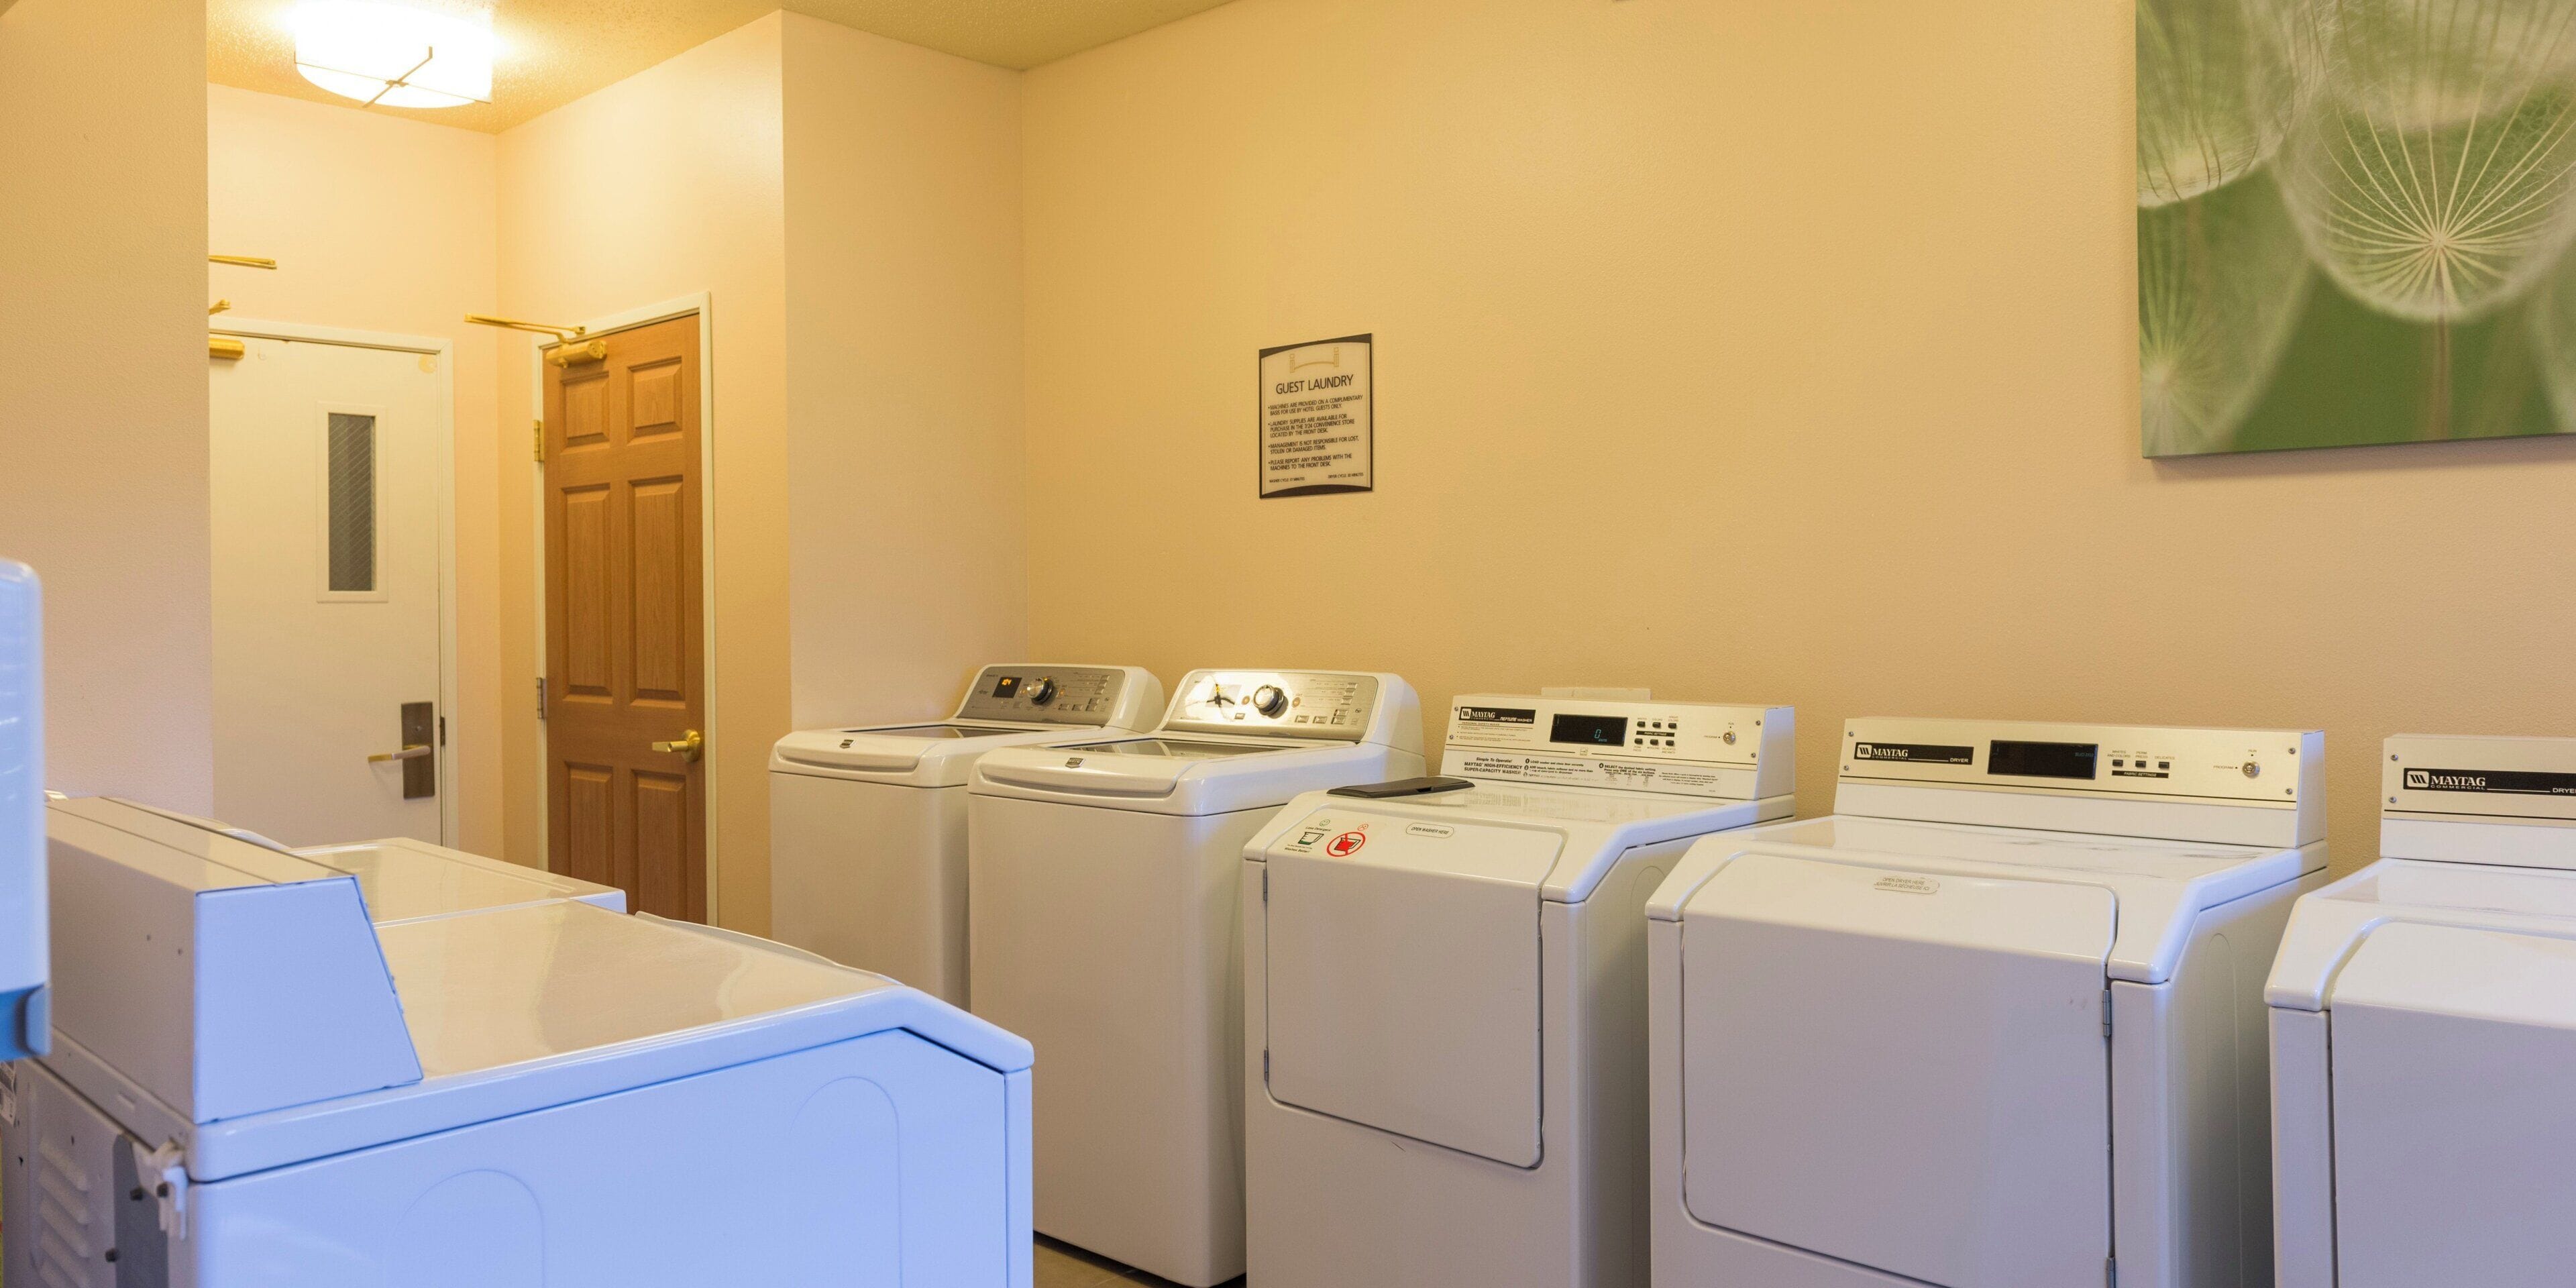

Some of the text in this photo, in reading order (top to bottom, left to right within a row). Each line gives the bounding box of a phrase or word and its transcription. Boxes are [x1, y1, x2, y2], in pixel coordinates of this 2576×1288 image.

[1276, 374, 1354, 394] GUEST LAUNDRY
[1330, 394, 1363, 402] COMPLIMENTARY
[1594, 729, 1602, 739] 0
[1873, 749, 1908, 757] MAYTAG
[2430, 775, 2485, 786] MAYTAG
